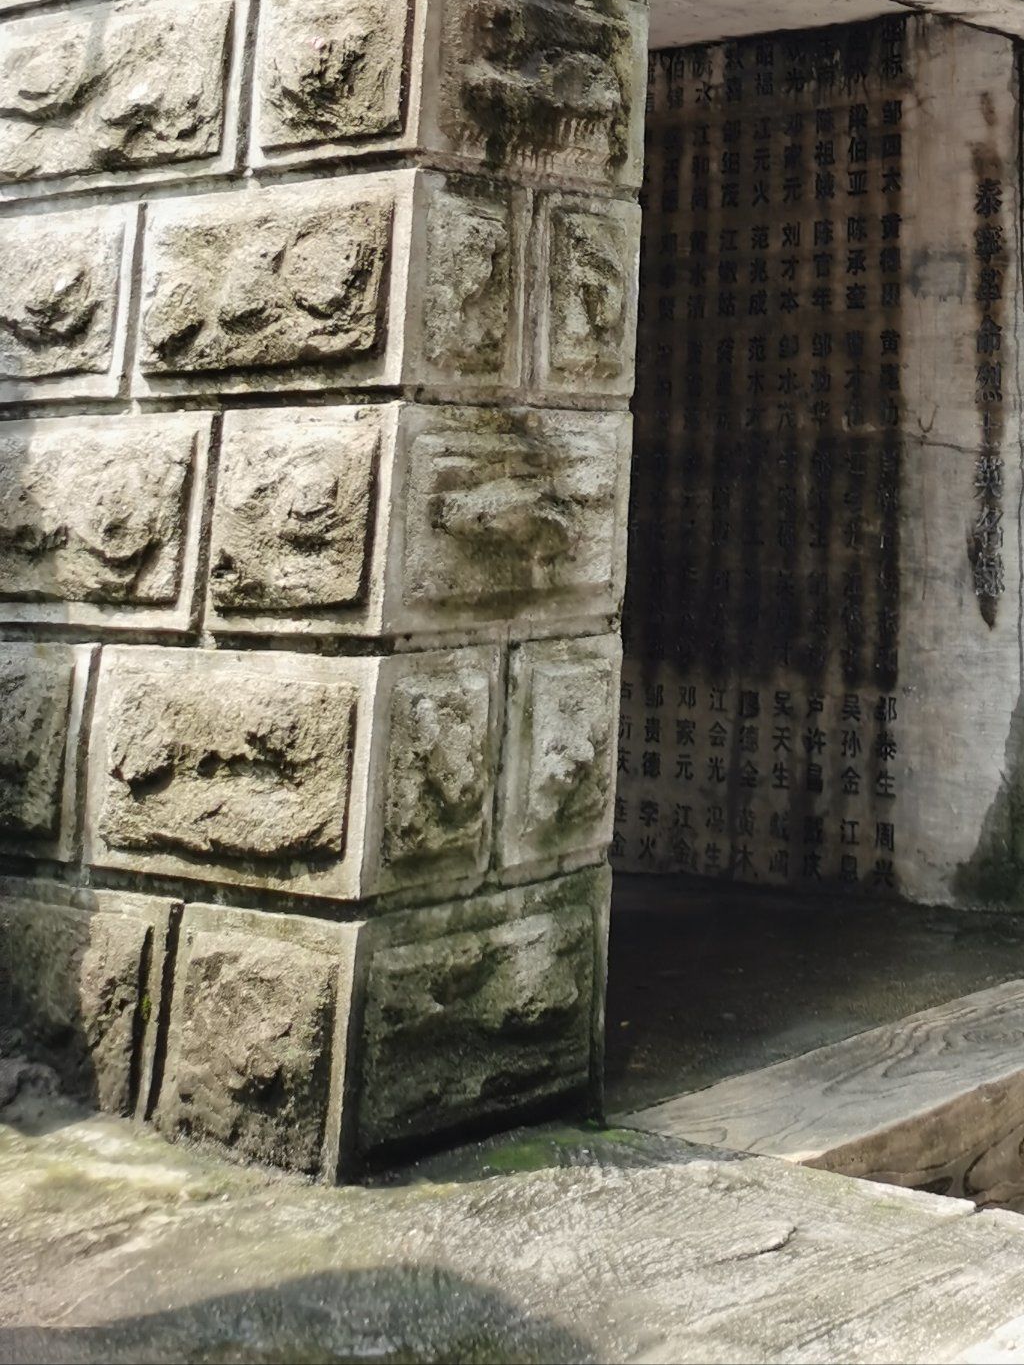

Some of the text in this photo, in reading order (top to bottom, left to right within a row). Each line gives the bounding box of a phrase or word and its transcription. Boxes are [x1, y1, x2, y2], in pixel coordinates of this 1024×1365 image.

[751, 116, 771, 206] 江元火
[676, 686, 697, 781] 邓家元
[709, 687, 728, 783] 江会光
[772, 690, 794, 790] 吴天生
